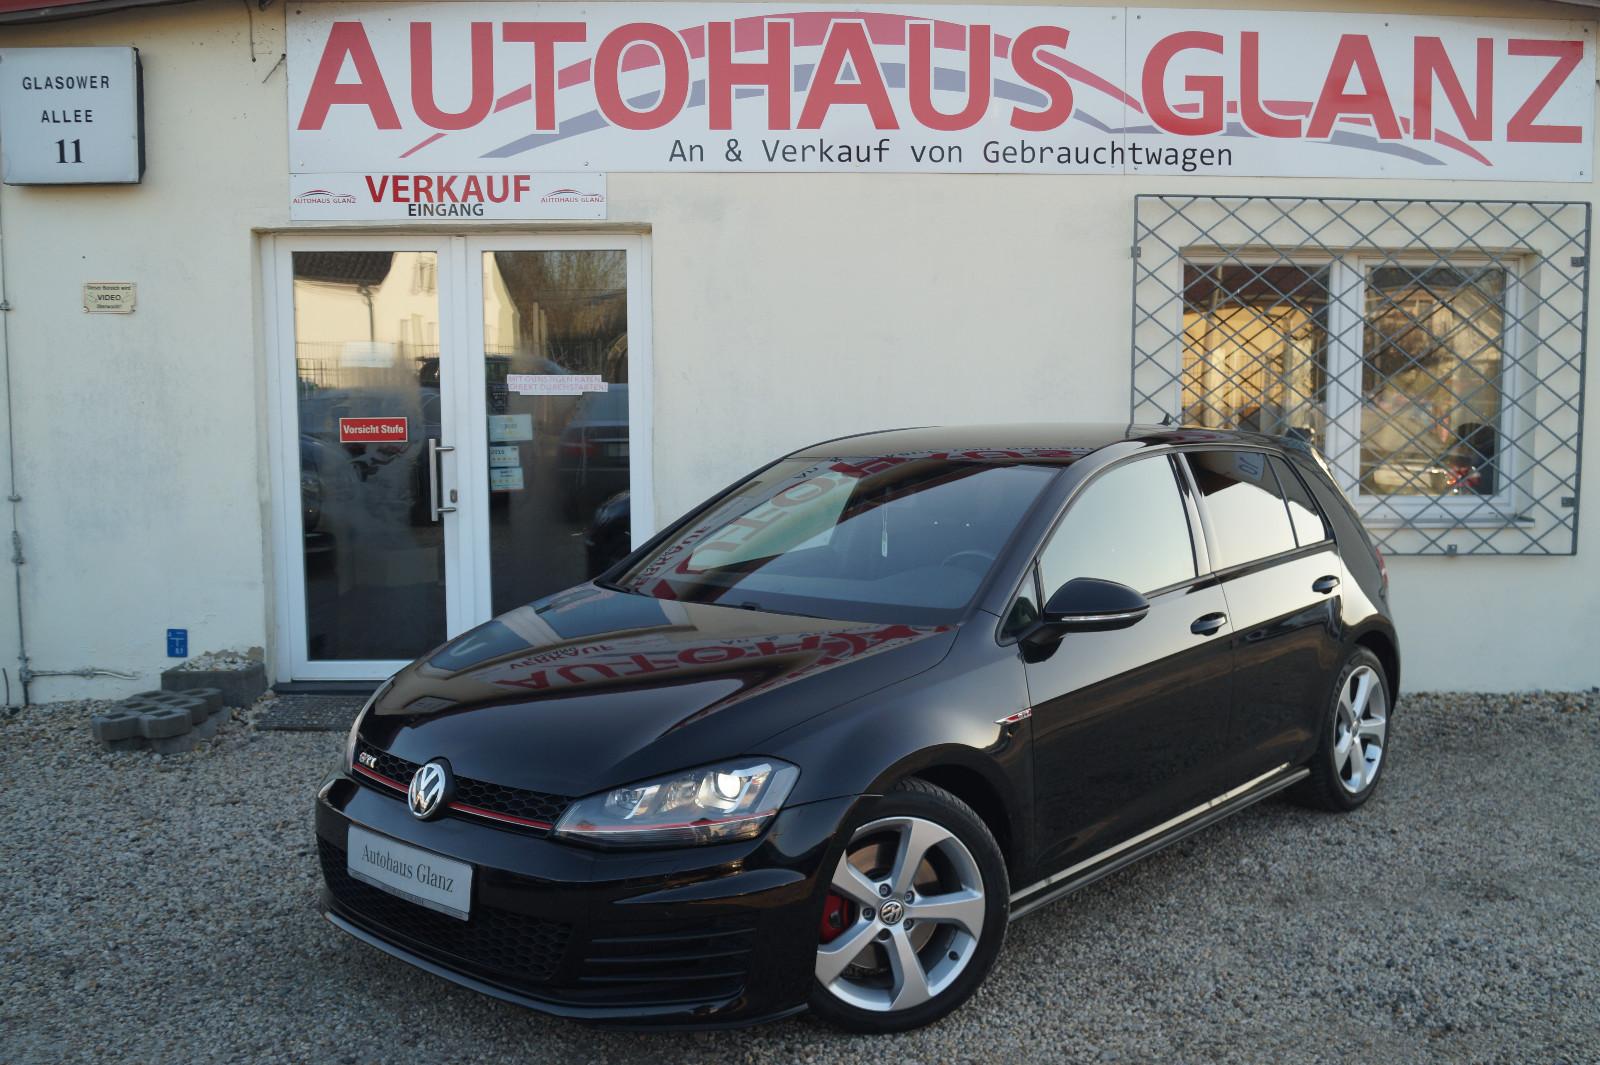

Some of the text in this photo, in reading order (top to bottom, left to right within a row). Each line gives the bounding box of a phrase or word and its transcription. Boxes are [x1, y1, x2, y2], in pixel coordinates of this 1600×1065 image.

[22, 75, 110, 90] GLASOWER
[297, 21, 1585, 144] AUTOHAUS GLANZ
[41, 109, 93, 123] ALLEE
[55, 138, 84, 164] 11
[669, 138, 1232, 172] An & Verkauf von Gebrauchtwagen
[365, 174, 531, 203] VERKAUF
[408, 203, 484, 217] EINGANG
[343, 424, 404, 434] Vorsicht Stufe
[362, 844, 454, 893] Autohaus Glanz
